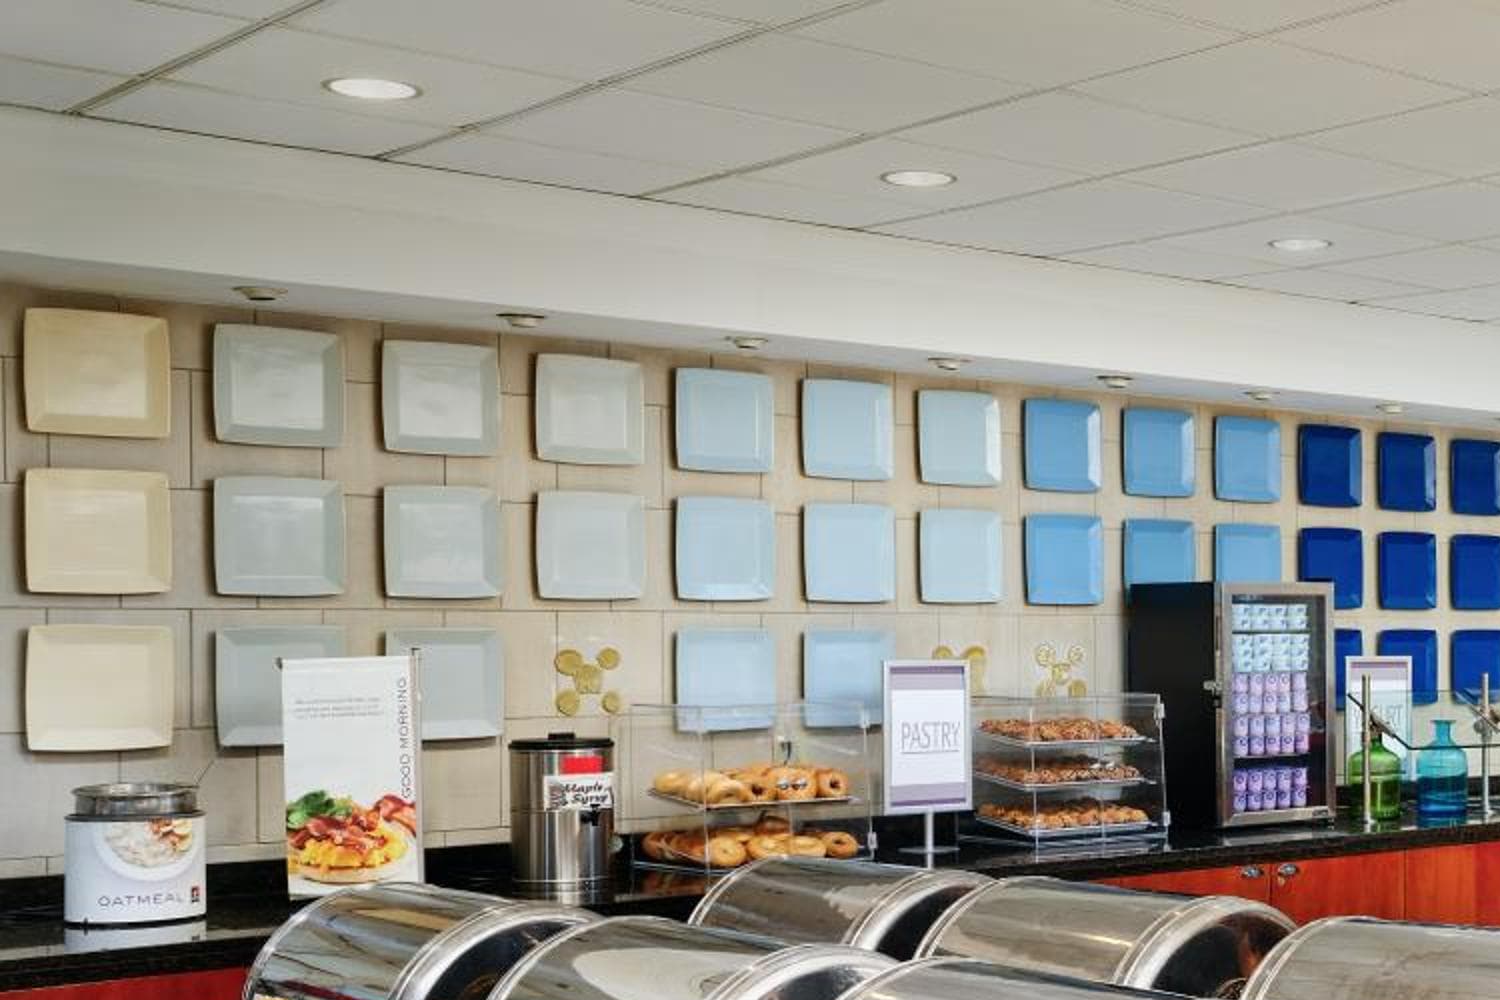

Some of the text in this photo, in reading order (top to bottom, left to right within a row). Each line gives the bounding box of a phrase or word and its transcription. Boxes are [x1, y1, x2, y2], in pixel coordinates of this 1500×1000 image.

[397, 677, 412, 799] GOOD MORNING
[900, 720, 961, 751] PASTRY
[97, 892, 186, 908] OATMEAL
